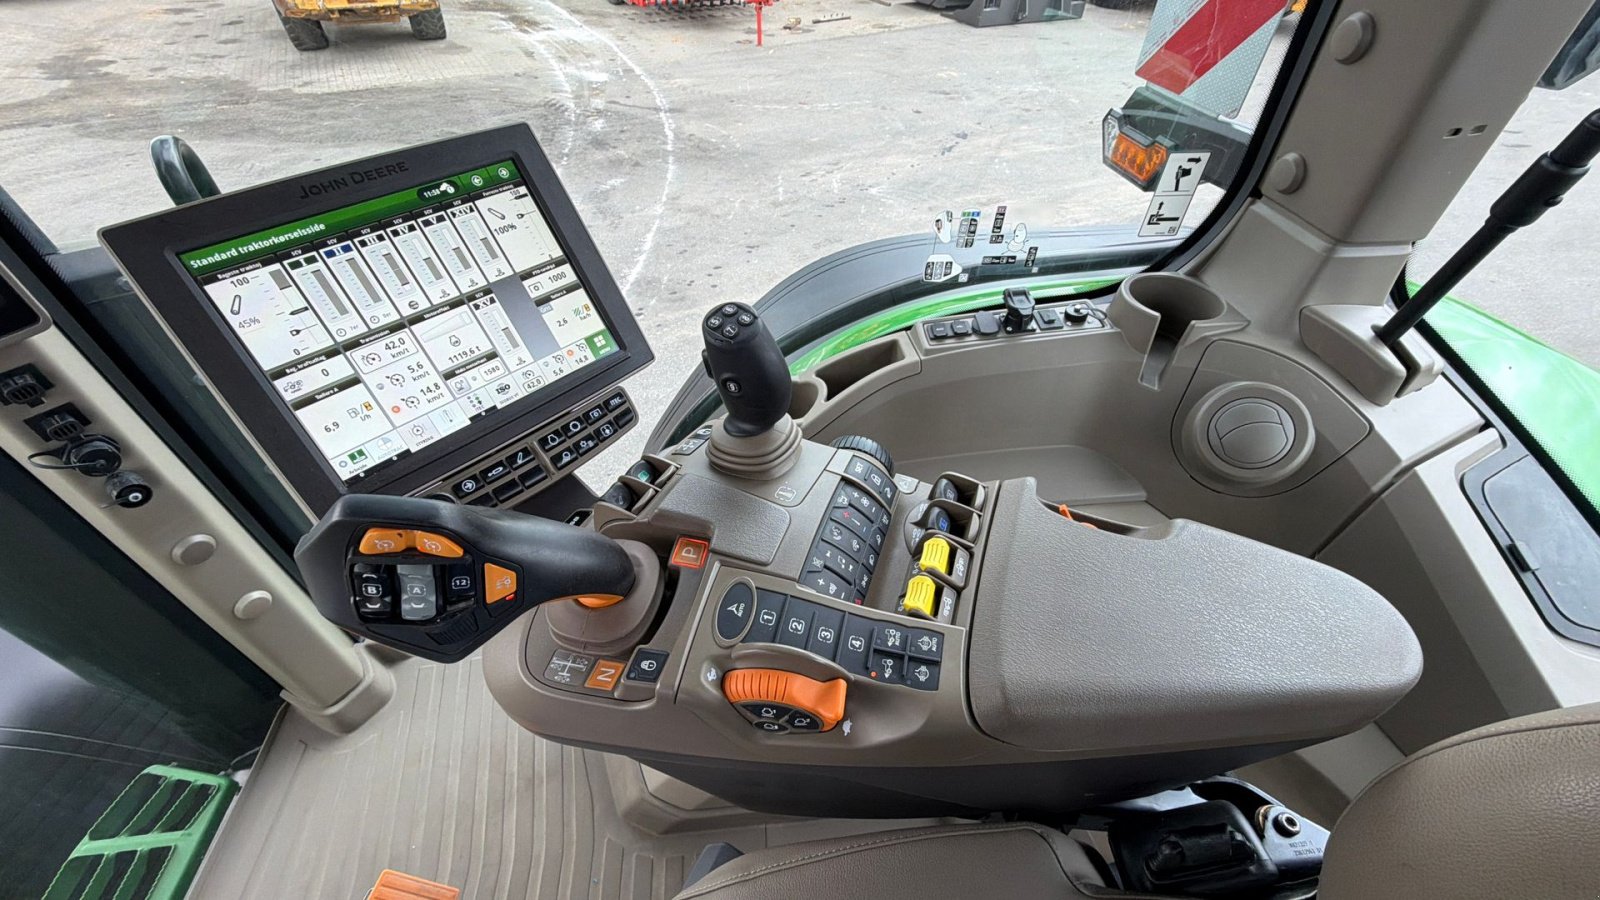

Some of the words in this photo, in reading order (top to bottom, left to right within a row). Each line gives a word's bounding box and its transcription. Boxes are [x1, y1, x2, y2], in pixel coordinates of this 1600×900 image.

[299, 176, 349, 200] JOHN
[349, 161, 409, 185] DEERE
[454, 206, 472, 218] XIV
[493, 223, 517, 236] 100%
[190, 246, 239, 269] Standard
[238, 223, 326, 254] traktorkørselsside
[230, 276, 250, 288] 100
[548, 271, 567, 284] 1000
[238, 316, 261, 329] 45%
[384, 337, 406, 351] 42,0
[293, 348, 301, 356] 0
[390, 347, 410, 359] km/t
[448, 347, 476, 364] 1119,6
[320, 368, 330, 377] 0
[407, 361, 424, 374] 5,6
[483, 365, 500, 376] 1580
[411, 370, 431, 382] km/t
[419, 382, 441, 396] 14,8
[495, 383, 511, 395] ISO
[526, 378, 542, 389] 42,0
[426, 392, 445, 404] km/t
[323, 421, 340, 433] 6,9
[681, 546, 697, 558] P
[737, 602, 745, 617] AUTO
[791, 622, 802, 631] 2
[820, 631, 831, 639] 3
[851, 640, 862, 648] 4
[596, 667, 616, 682] N
